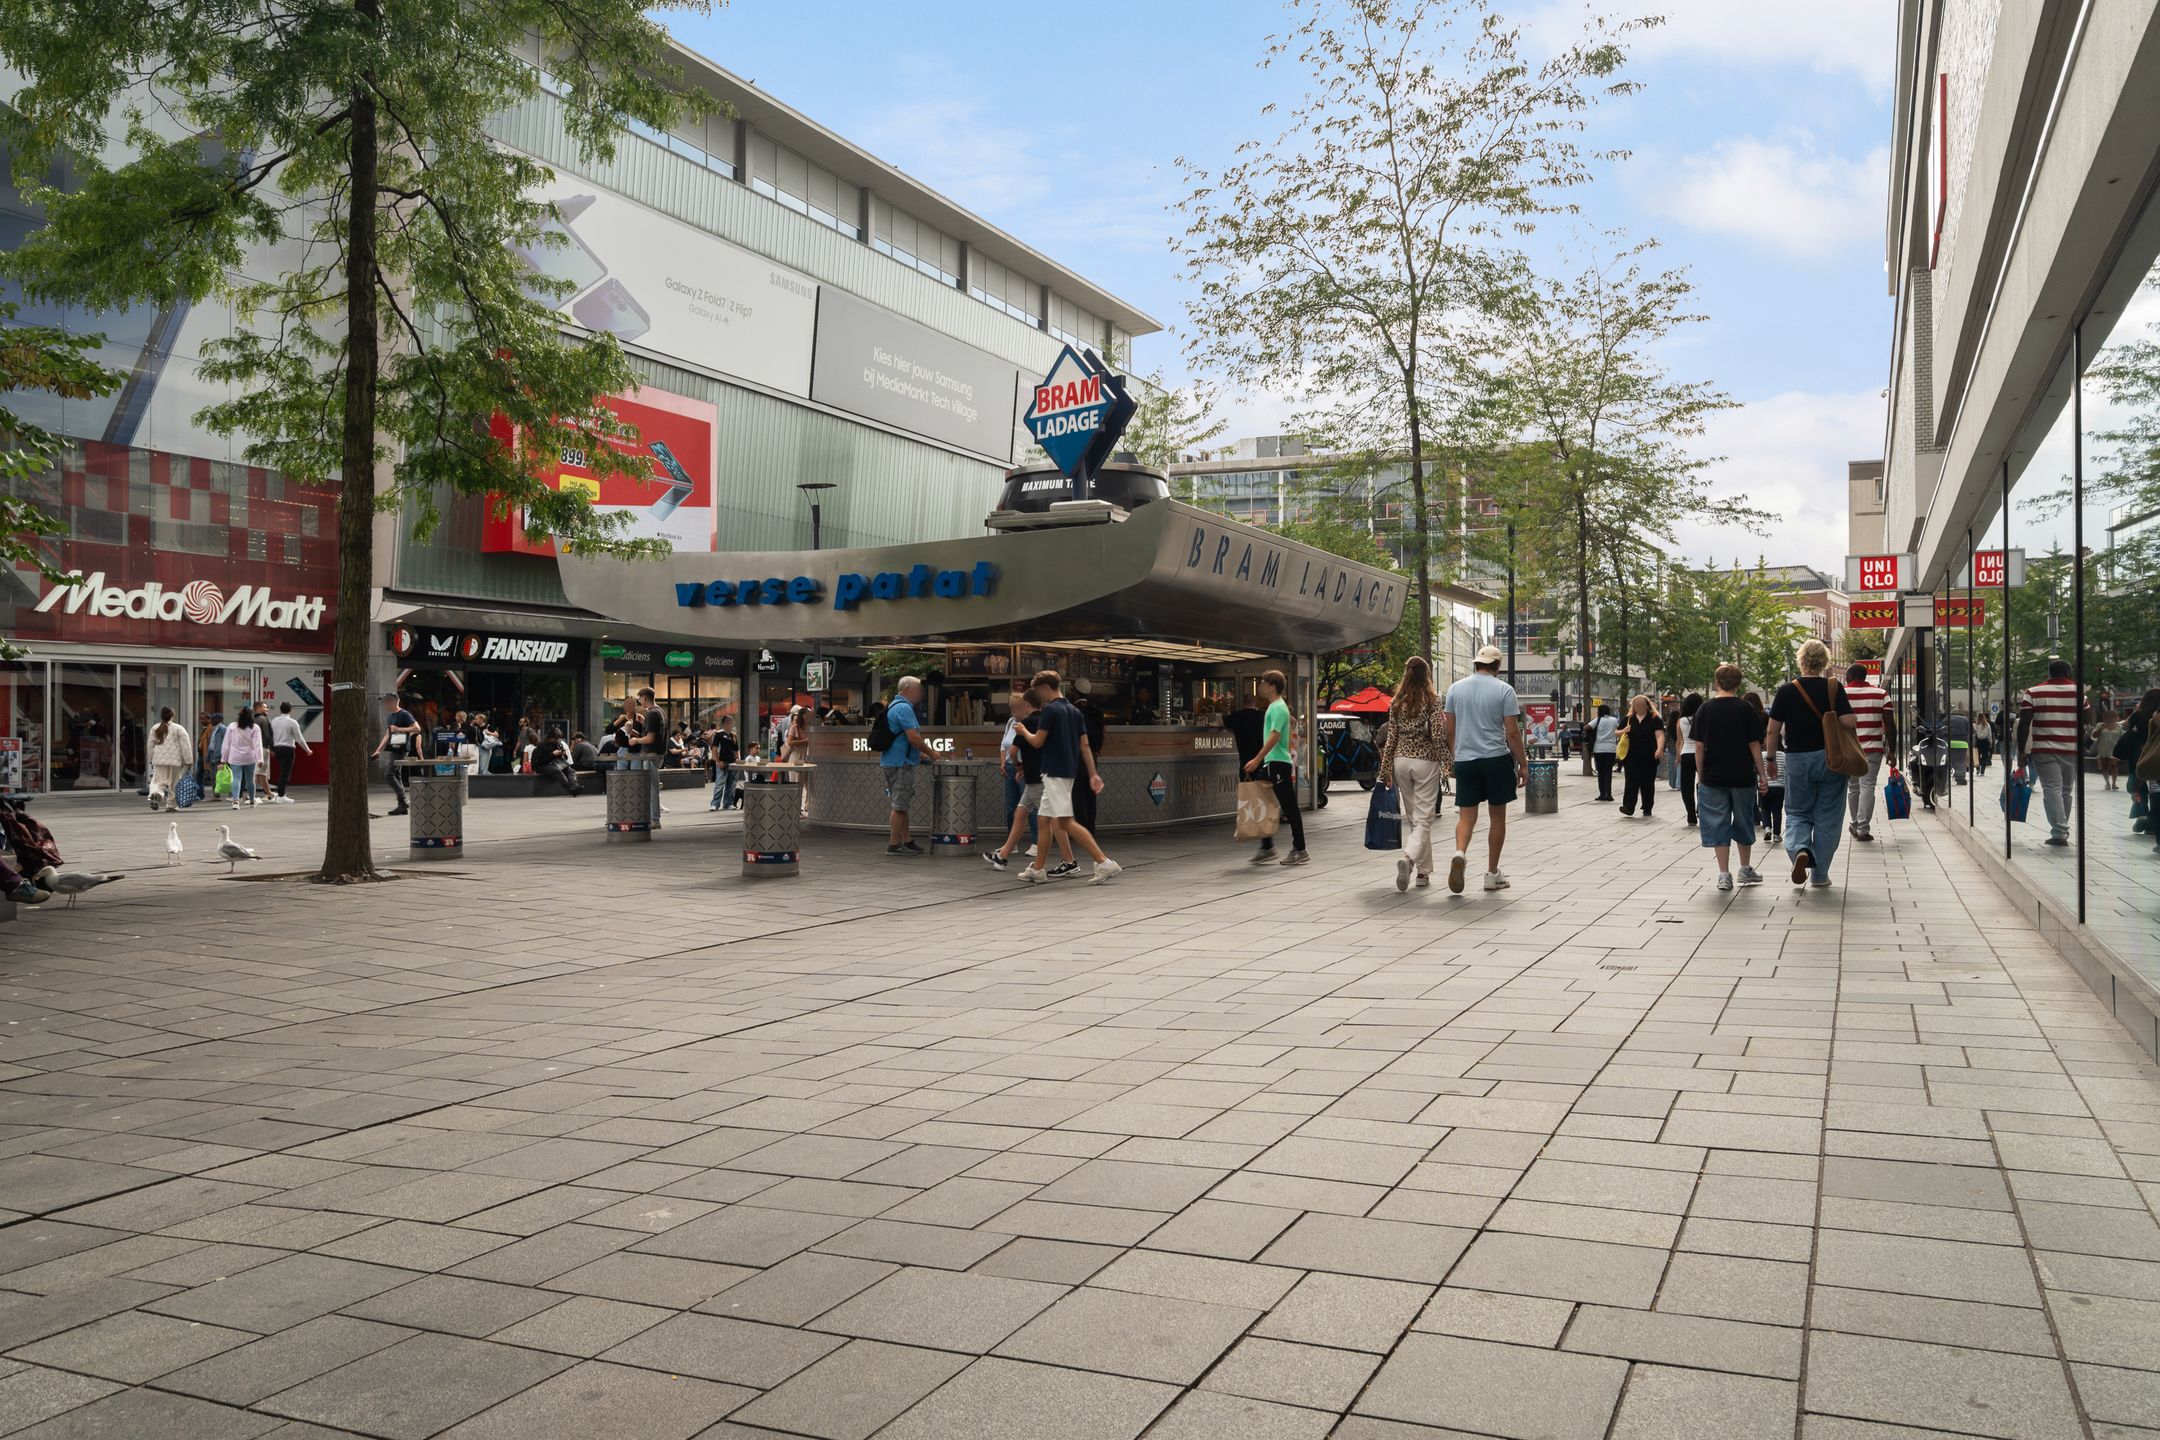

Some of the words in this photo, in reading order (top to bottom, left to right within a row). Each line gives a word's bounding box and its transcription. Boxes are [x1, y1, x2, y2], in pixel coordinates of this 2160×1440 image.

[769, 272, 813, 300] SAMSUNG
[665, 277, 697, 300] Galaxy
[697, 289, 704, 300] Z
[704, 291, 726, 308] Fold7
[729, 301, 735, 312] Z
[736, 303, 753, 319] Flip7
[688, 303, 715, 322] Galaxy
[873, 346, 892, 366] Kies
[893, 353, 912, 373] hier
[911, 360, 934, 380] jouw
[935, 370, 973, 401] Samsung
[863, 367, 876, 388] bij
[876, 371, 930, 403] MediaMarkt
[931, 391, 951, 412] Tech
[951, 398, 978, 422] Village
[1037, 375, 1100, 414] BRAM
[1036, 409, 1099, 440] LADAGE
[1021, 479, 1064, 492] MAXIMUM
[1187, 527, 1281, 588] BRAM
[1299, 561, 1393, 615] LADAGE
[1863, 560, 1892, 573] UNI
[675, 576, 822, 608] verse
[833, 560, 993, 611] patat
[1863, 573, 1894, 589] QLO
[34, 569, 184, 622] Media
[214, 584, 327, 631] Markt
[482, 637, 568, 663] FANSHOP
[704, 656, 734, 667] Opticiens
[757, 663, 776, 671] Normal
[1515, 685, 1542, 693] SHION
[1530, 675, 1553, 683] HAND
[1320, 721, 1346, 729] LADAGE
[1194, 738, 1211, 750] BRAM
[1212, 737, 1234, 749] LADAGE
